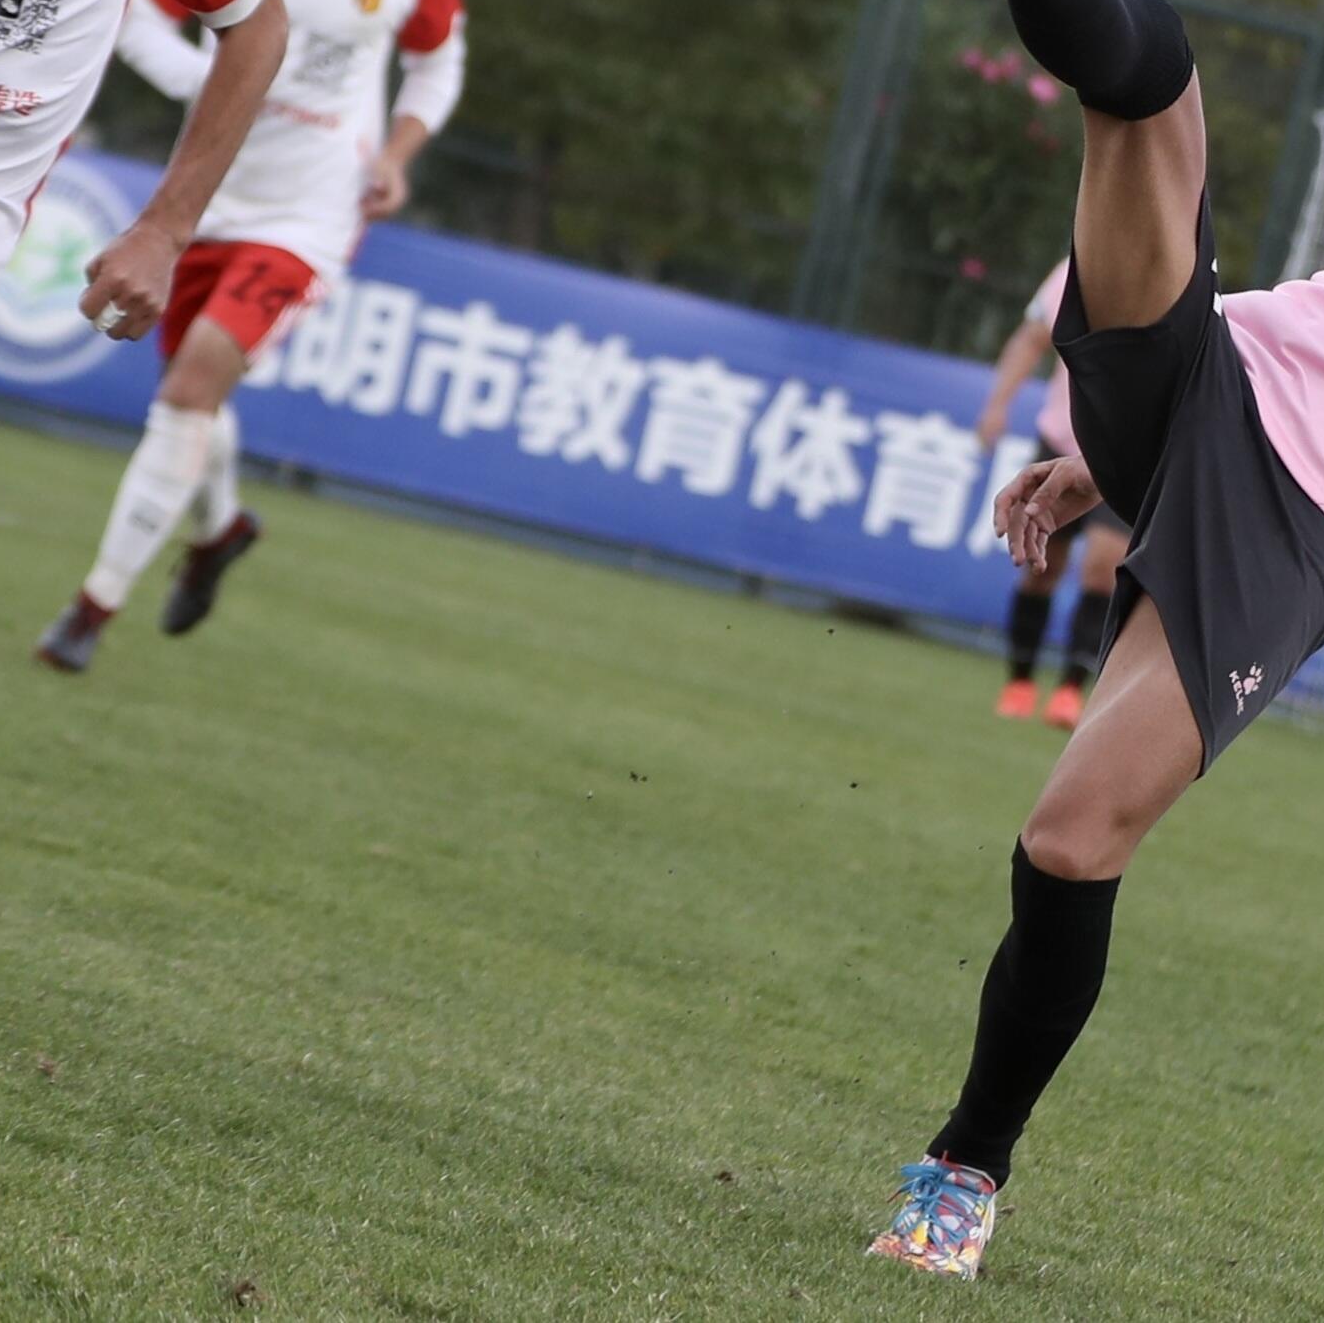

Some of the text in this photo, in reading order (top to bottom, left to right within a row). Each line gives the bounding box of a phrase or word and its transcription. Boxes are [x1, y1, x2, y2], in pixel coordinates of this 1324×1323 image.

[240, 277, 1039, 557] 明市教育体育
